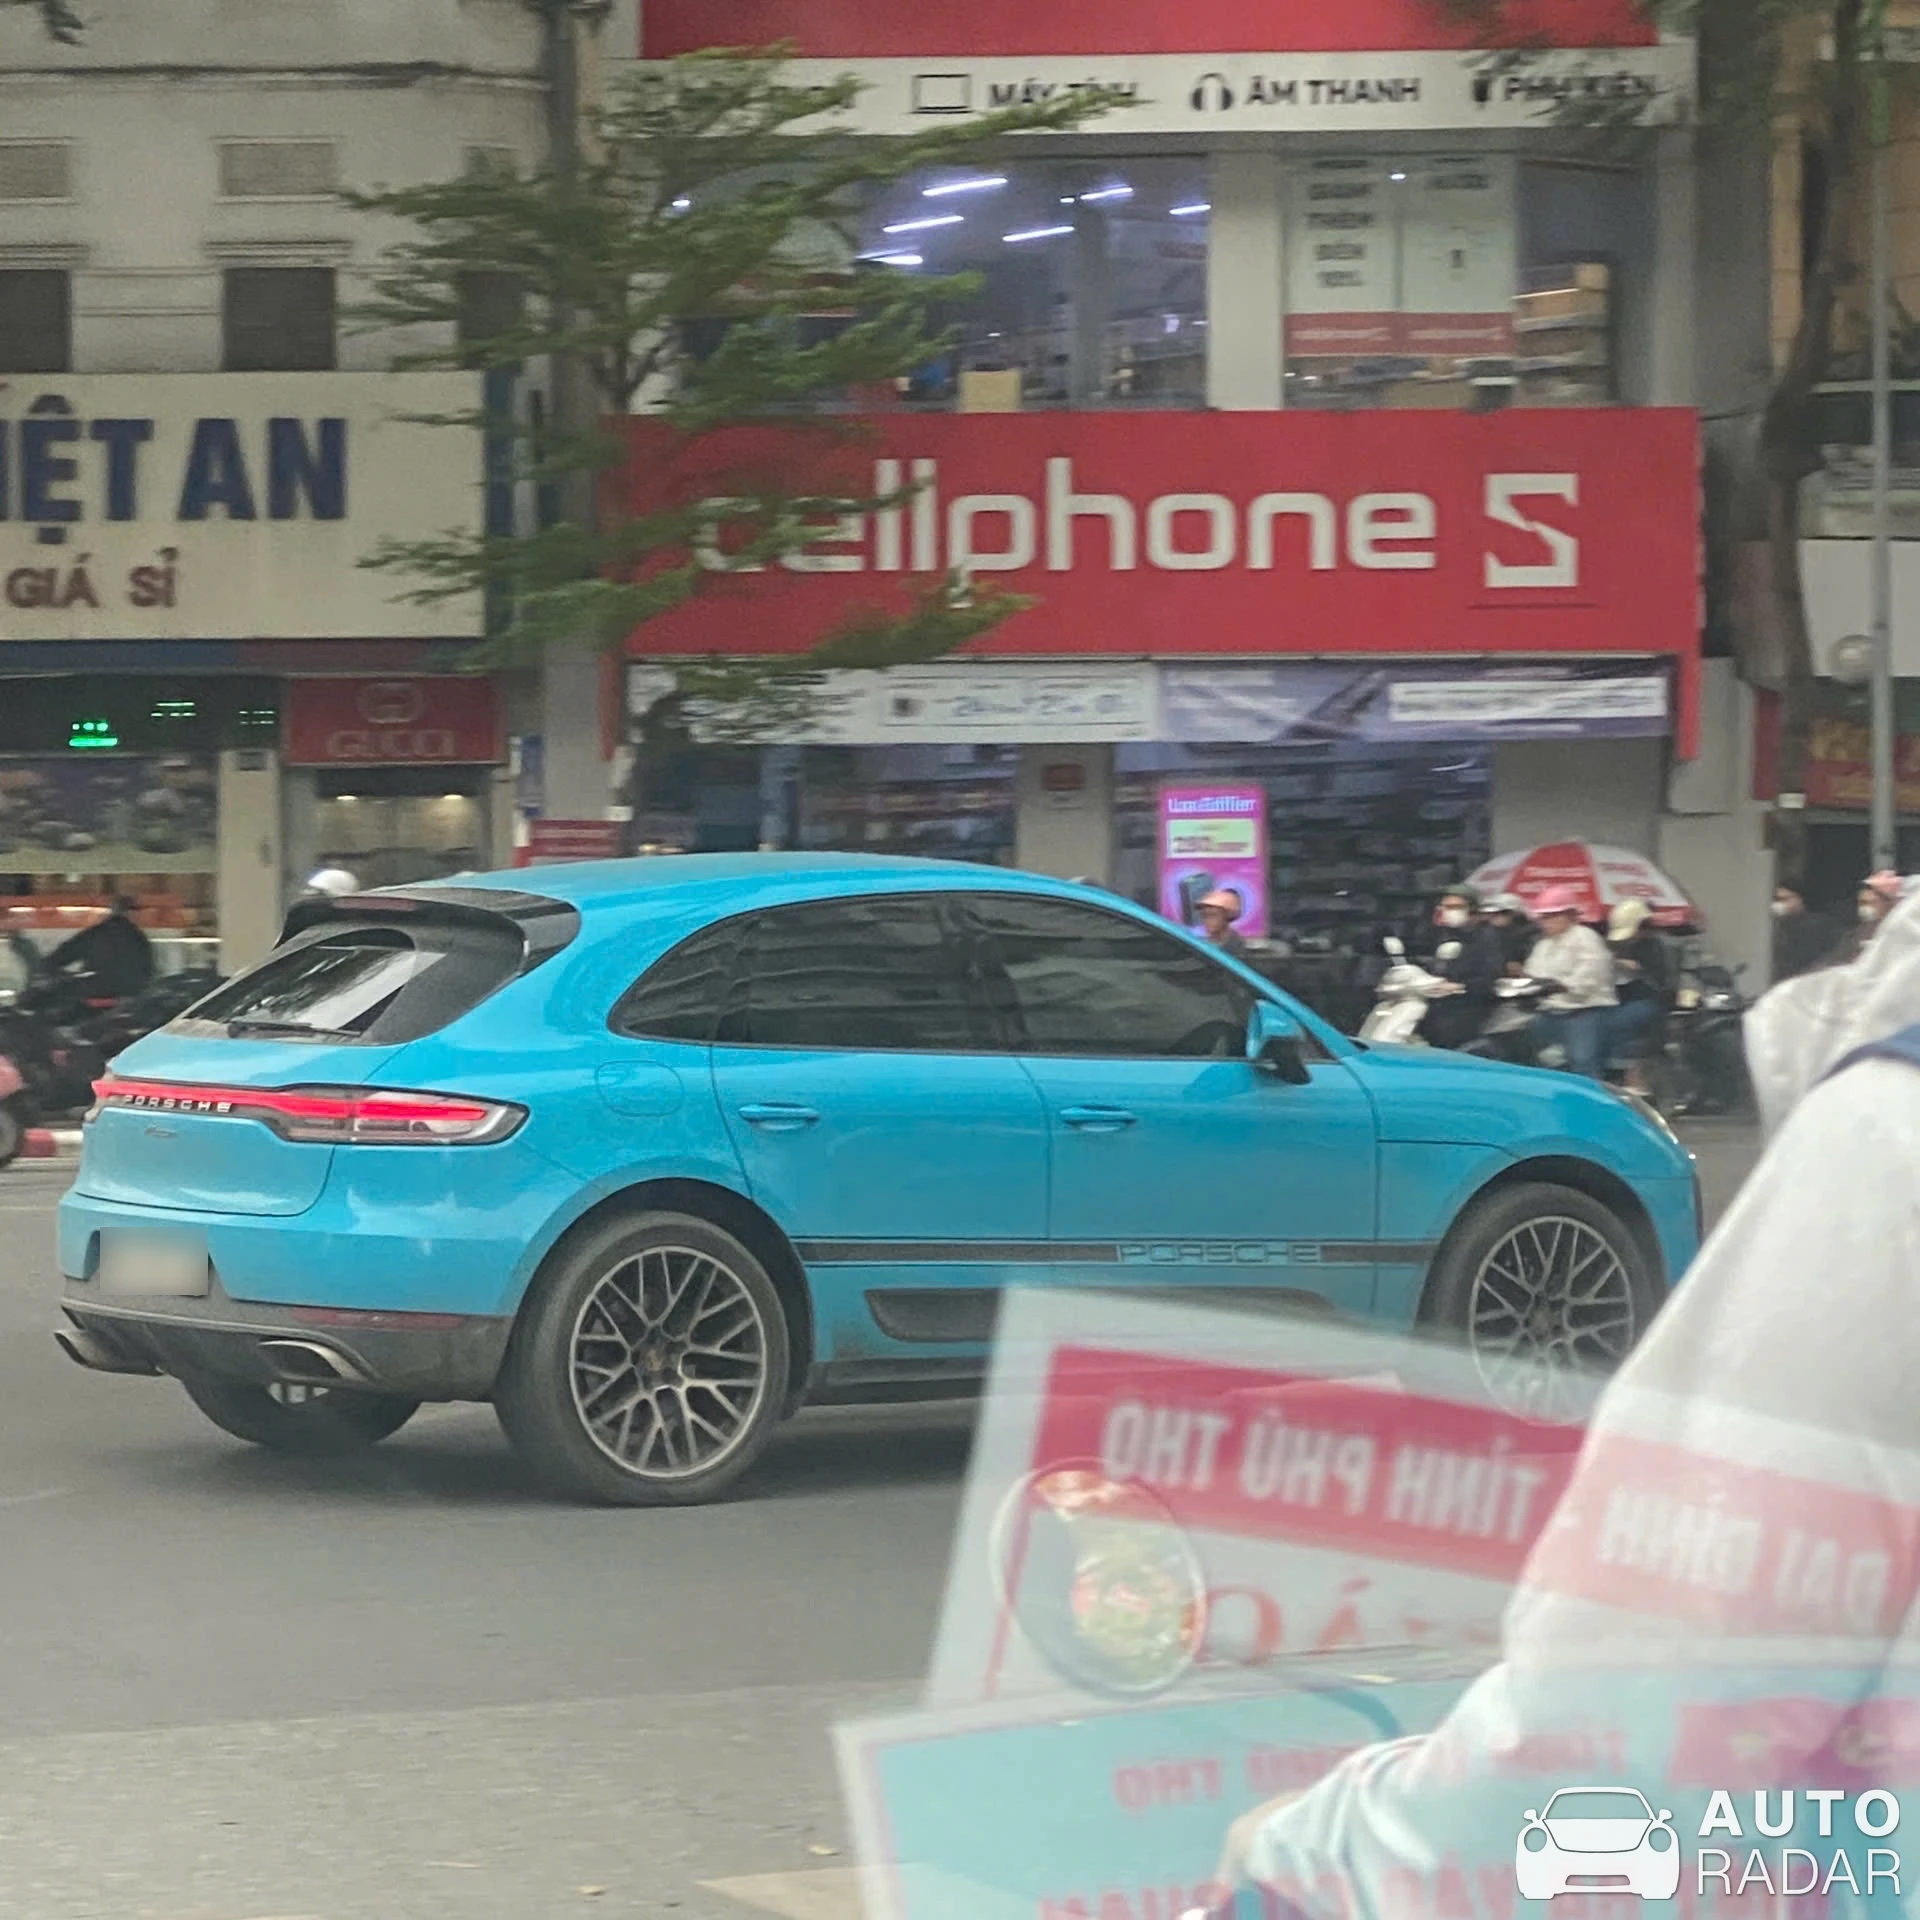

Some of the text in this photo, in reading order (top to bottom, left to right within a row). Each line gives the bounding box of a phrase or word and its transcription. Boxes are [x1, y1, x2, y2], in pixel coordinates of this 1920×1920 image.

[1245, 73, 1421, 105] ÂM THANH
[0, 394, 348, 545] ỆT AN
[6, 546, 179, 608] GIÁ SỈ
[124, 1094, 233, 1113] PORSCHE
[1117, 1242, 1321, 1263] PORSCHE
